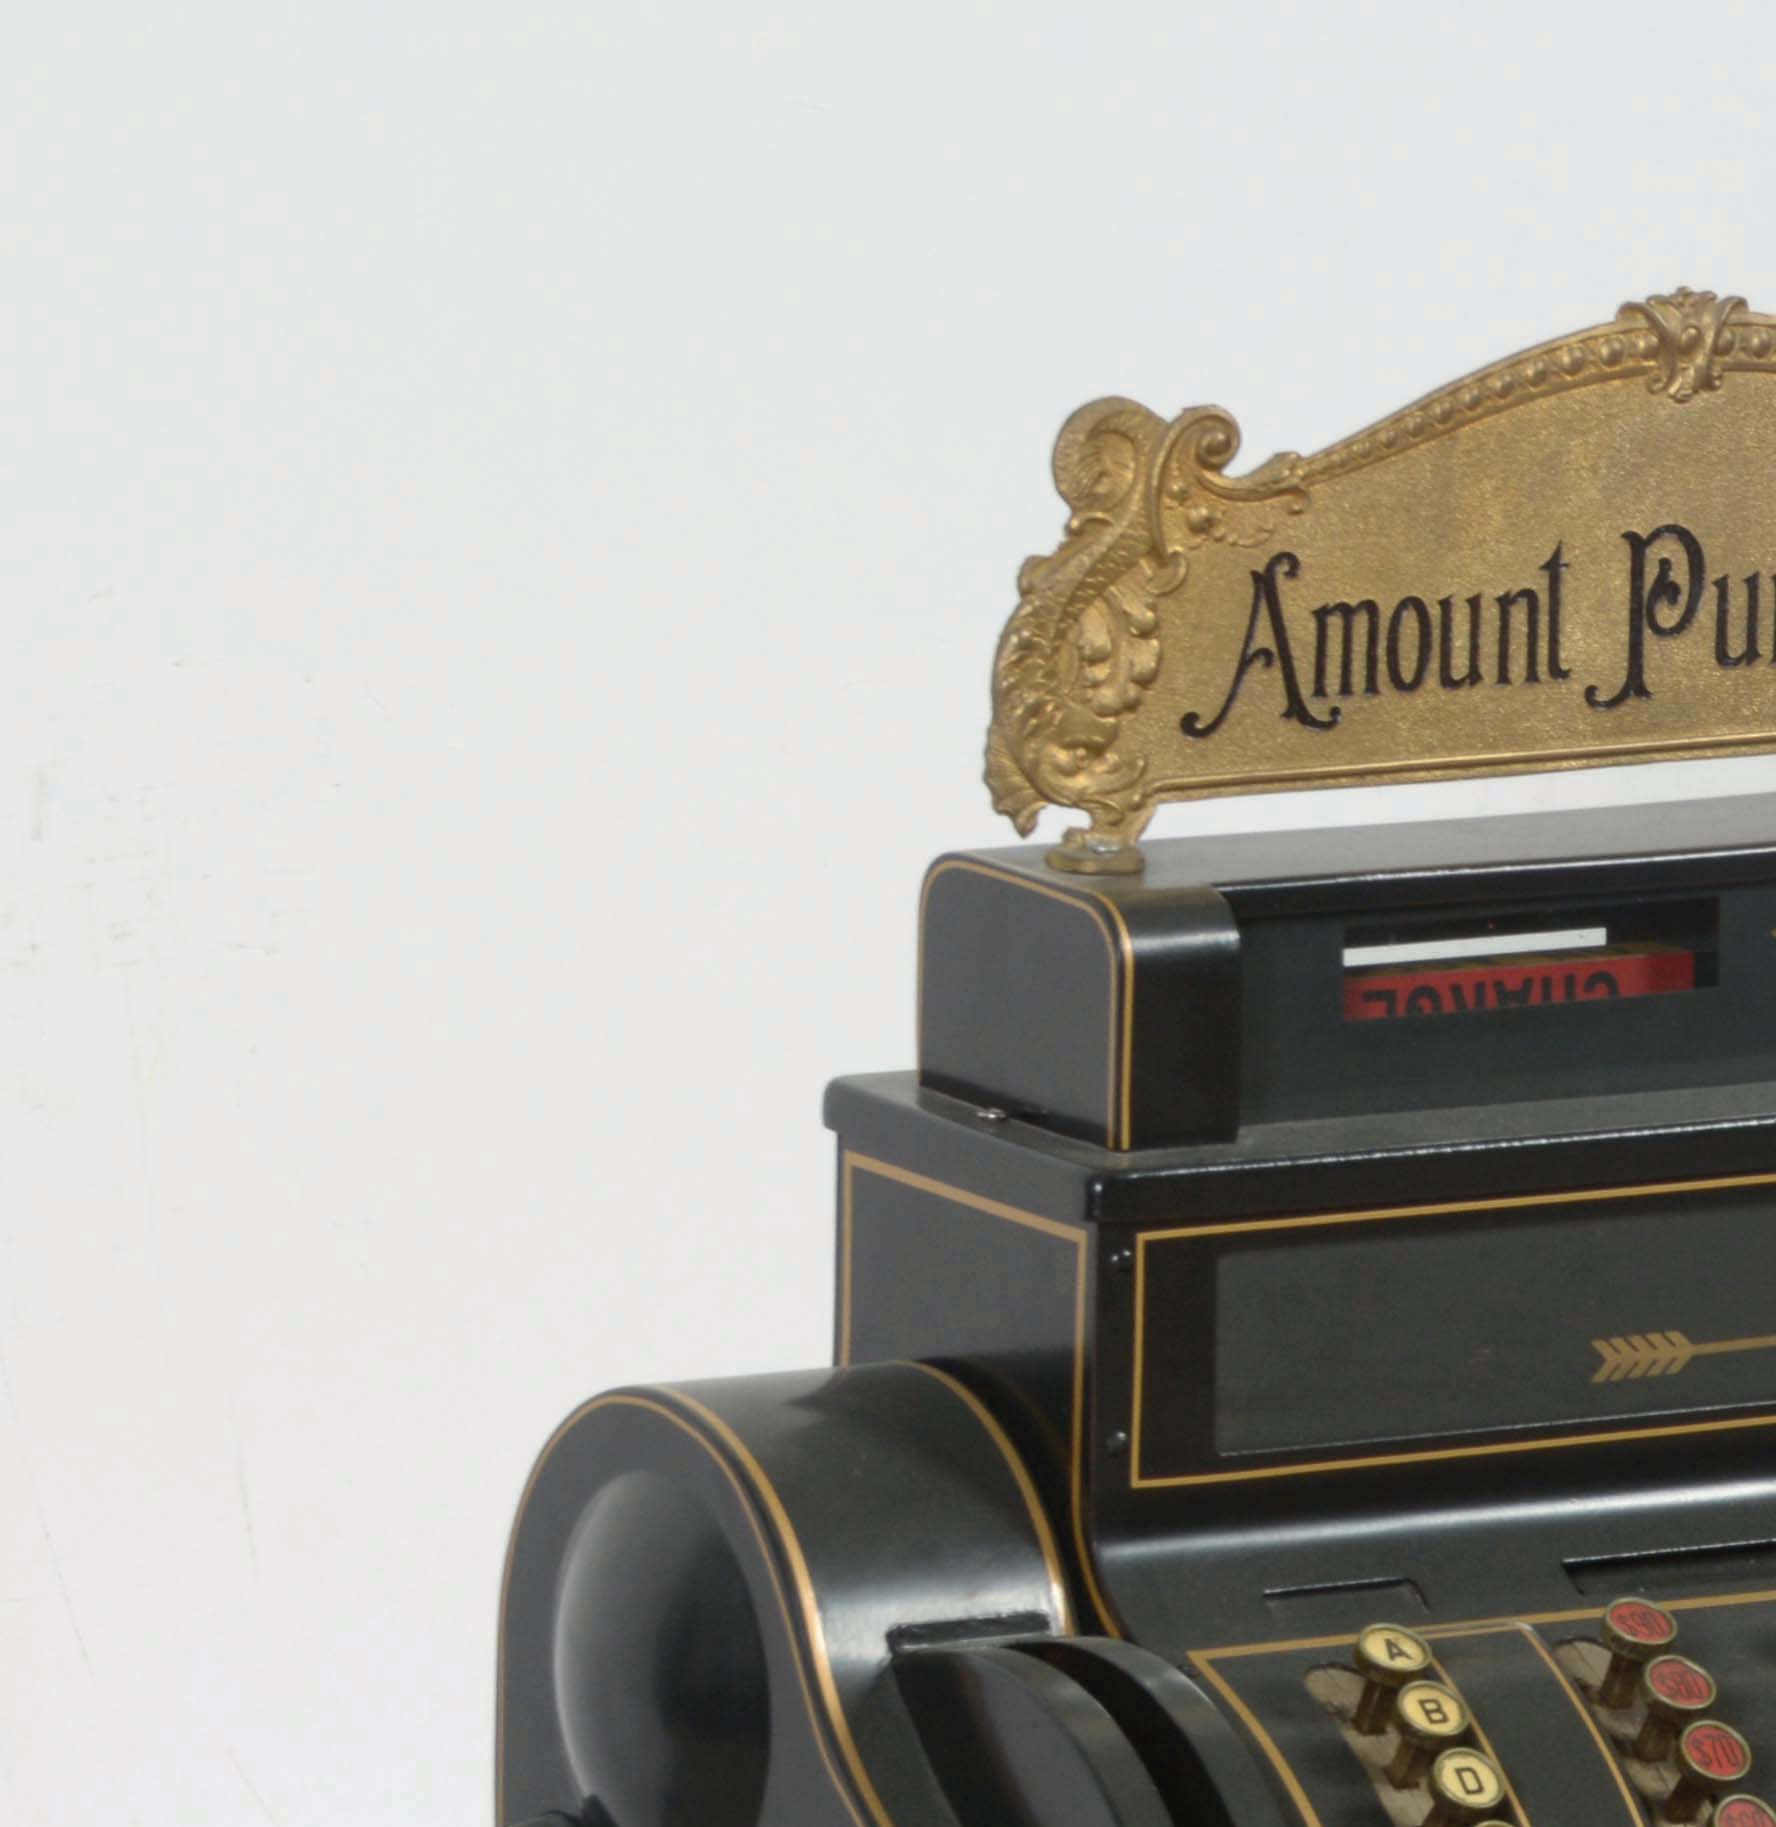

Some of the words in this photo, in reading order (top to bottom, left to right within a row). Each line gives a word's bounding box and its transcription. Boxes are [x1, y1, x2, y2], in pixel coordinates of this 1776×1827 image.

[1180, 538, 1572, 740] Amount
[1384, 1638, 1414, 1662] A
[1418, 1697, 1449, 1725] B
[1454, 1766, 1485, 1796] D
